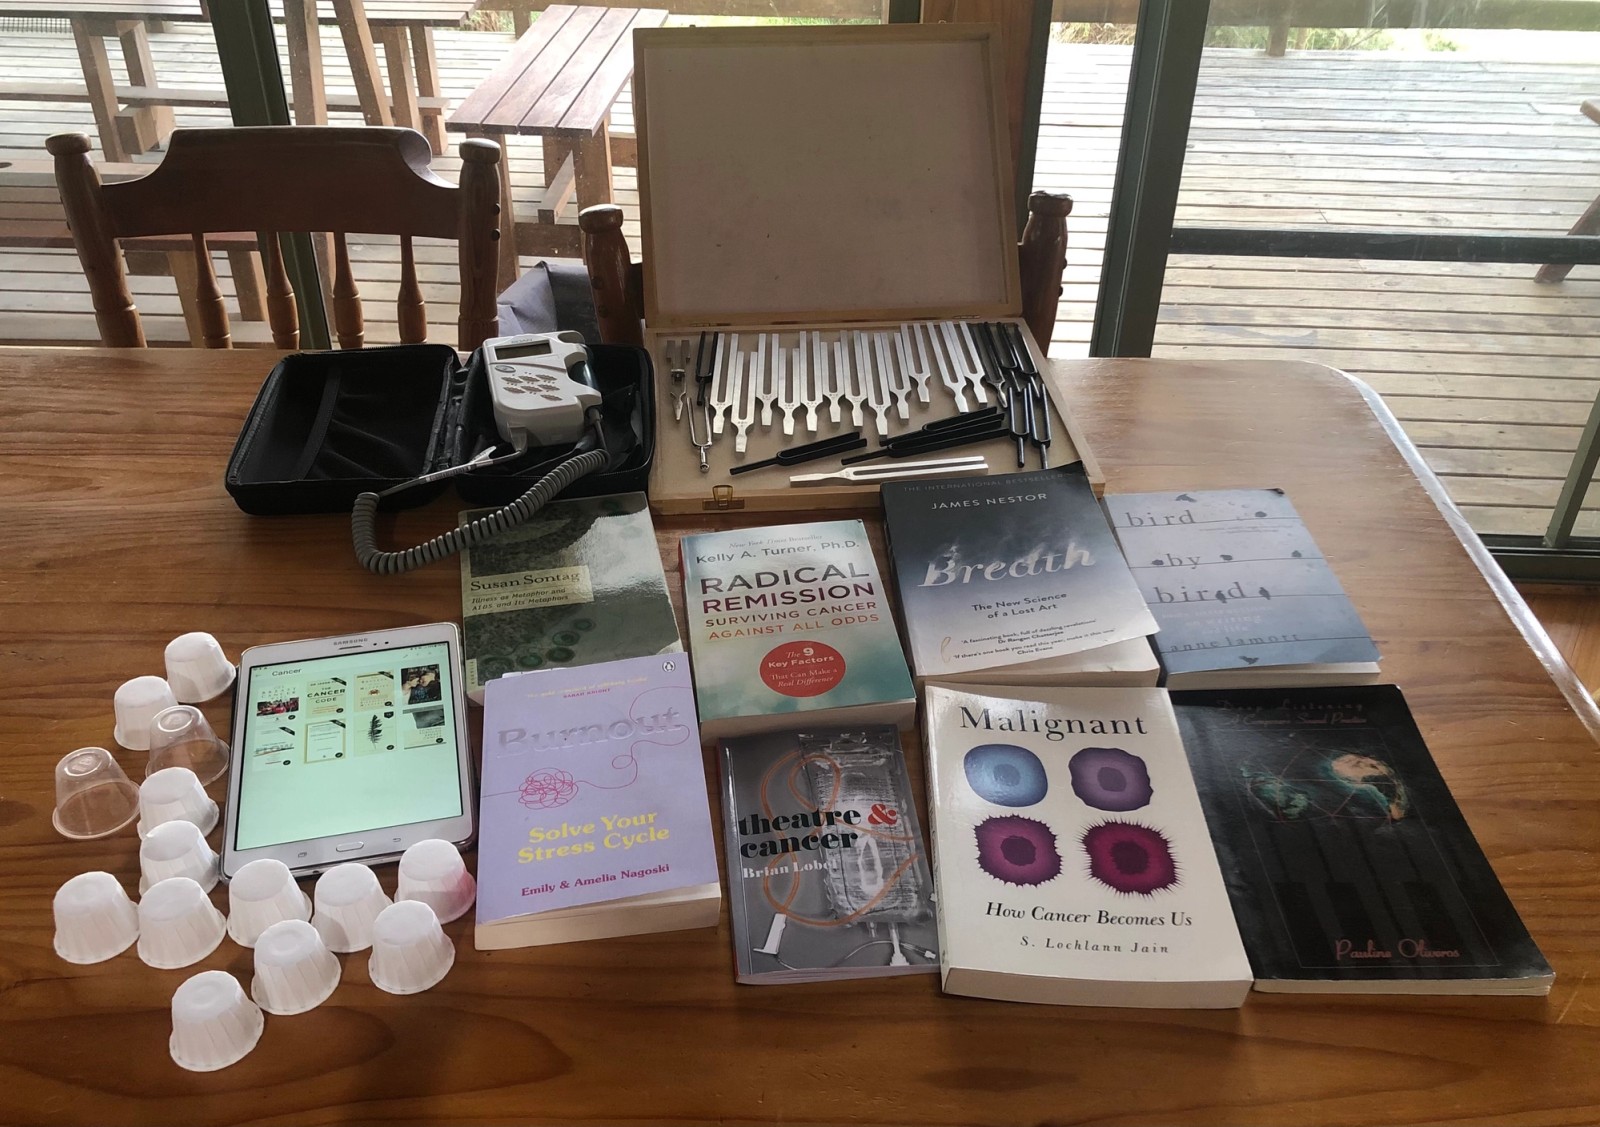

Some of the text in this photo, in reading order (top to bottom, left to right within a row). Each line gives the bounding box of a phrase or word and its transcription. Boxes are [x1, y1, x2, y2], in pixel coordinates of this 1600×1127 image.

[924, 480, 1002, 491] INTERNATIONAL
[931, 493, 1048, 510] JAMES NESTOR
[1125, 509, 1197, 528] bird
[696, 539, 860, 564] Kelly A. Turner, Ph.D.
[917, 543, 1097, 587] Breath
[1167, 553, 1201, 570] by
[470, 573, 581, 592] Susan Sontag
[699, 562, 870, 595] RADICAL
[472, 596, 498, 604] Illness
[512, 590, 549, 599] Metaphor
[496, 600, 512, 608] and
[527, 594, 569, 605] Metaphors
[702, 582, 875, 614] REMISSION
[971, 592, 1067, 611] The New Science
[1154, 582, 1247, 604] bird
[705, 601, 877, 628] SURVIVING CANCER
[987, 611, 1000, 620] of
[1011, 606, 1036, 616] Lost
[1039, 602, 1058, 611] Art
[708, 613, 880, 641] AGAINST ALL ODDS
[333, 637, 368, 646] SAMSUNG
[1169, 634, 1302, 652] anne lamott
[768, 655, 835, 669] Key Factors
[785, 647, 814, 658] The 9
[271, 667, 302, 677] Cancer
[771, 673, 789, 681] That
[790, 671, 807, 679] Can
[809, 668, 831, 677] Make
[777, 676, 834, 688] Real Difference
[306, 688, 347, 699] CANCER
[315, 696, 337, 704] CODE
[497, 707, 682, 758] Burnout
[958, 706, 1148, 742] Malignant
[529, 812, 658, 845] Solve Your
[738, 803, 898, 836] theatre &
[517, 826, 670, 865] Stress Cycle
[740, 831, 859, 858] cancer
[742, 860, 838, 880] Brian Lobel
[521, 863, 670, 897] Emily & Amelia Nagoski
[985, 901, 1193, 927] How Cancer Becomes Us
[1020, 935, 1169, 953] S. Lochlann Jain
[1334, 937, 1461, 961] Pauline Oliveros
